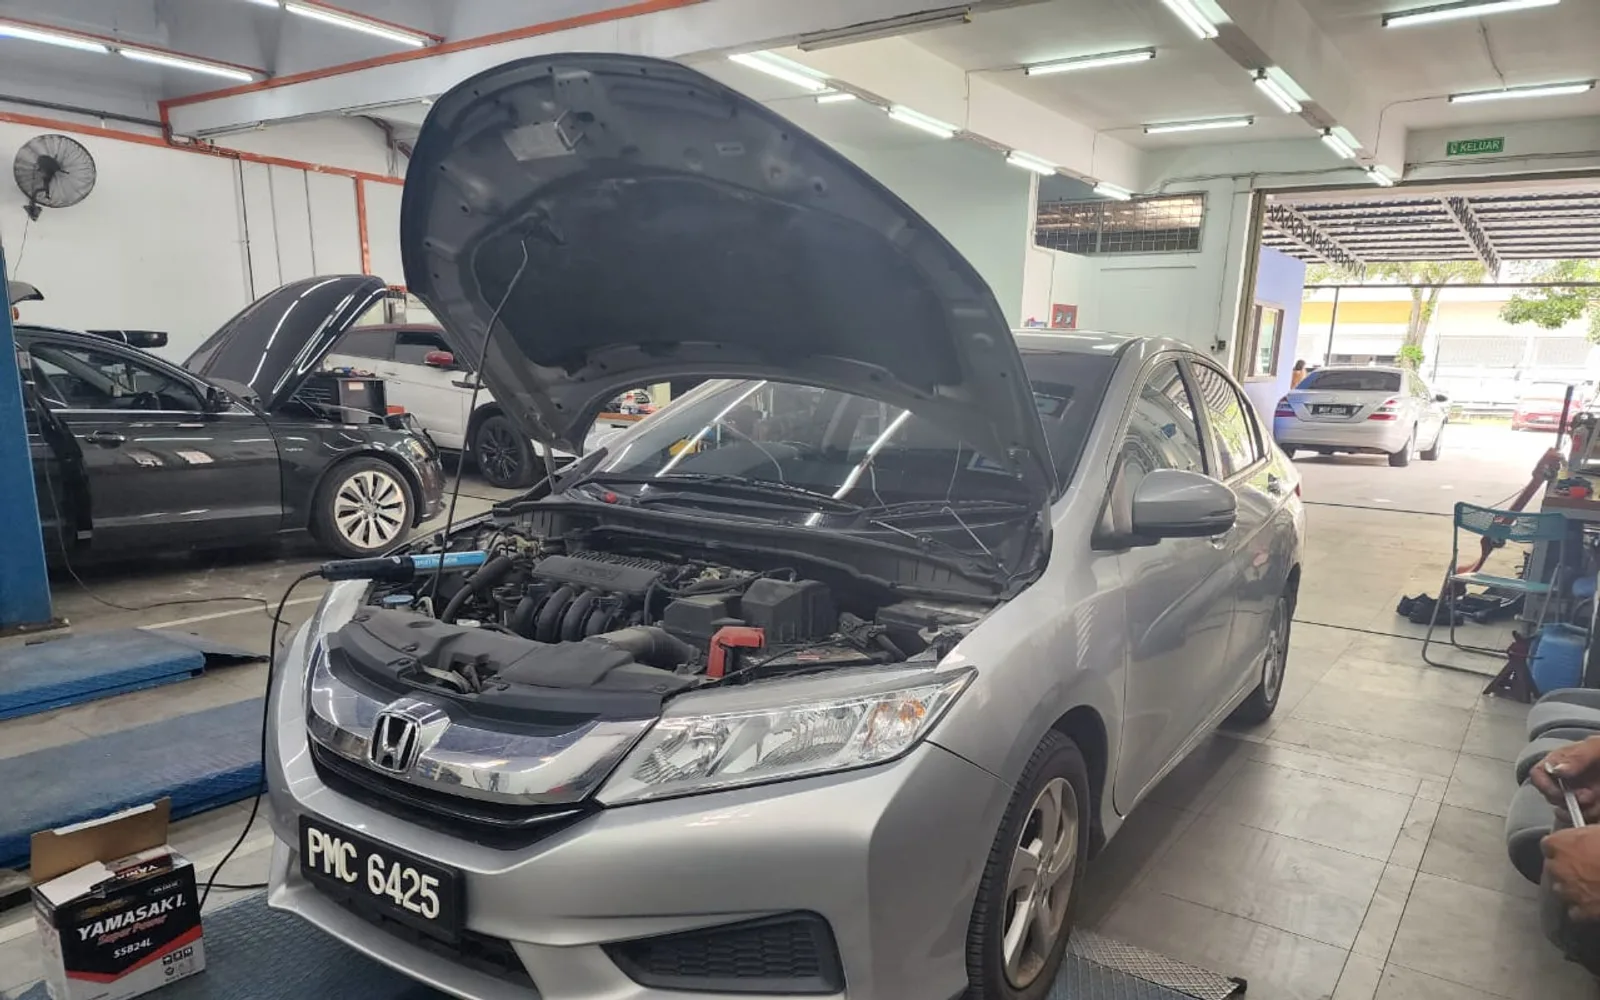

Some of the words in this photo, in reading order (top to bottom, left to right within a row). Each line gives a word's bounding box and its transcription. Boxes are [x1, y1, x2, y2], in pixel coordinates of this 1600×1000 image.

[1460, 140, 1500, 153] KELUAR
[308, 827, 358, 883] PMC
[367, 853, 440, 919] 6425
